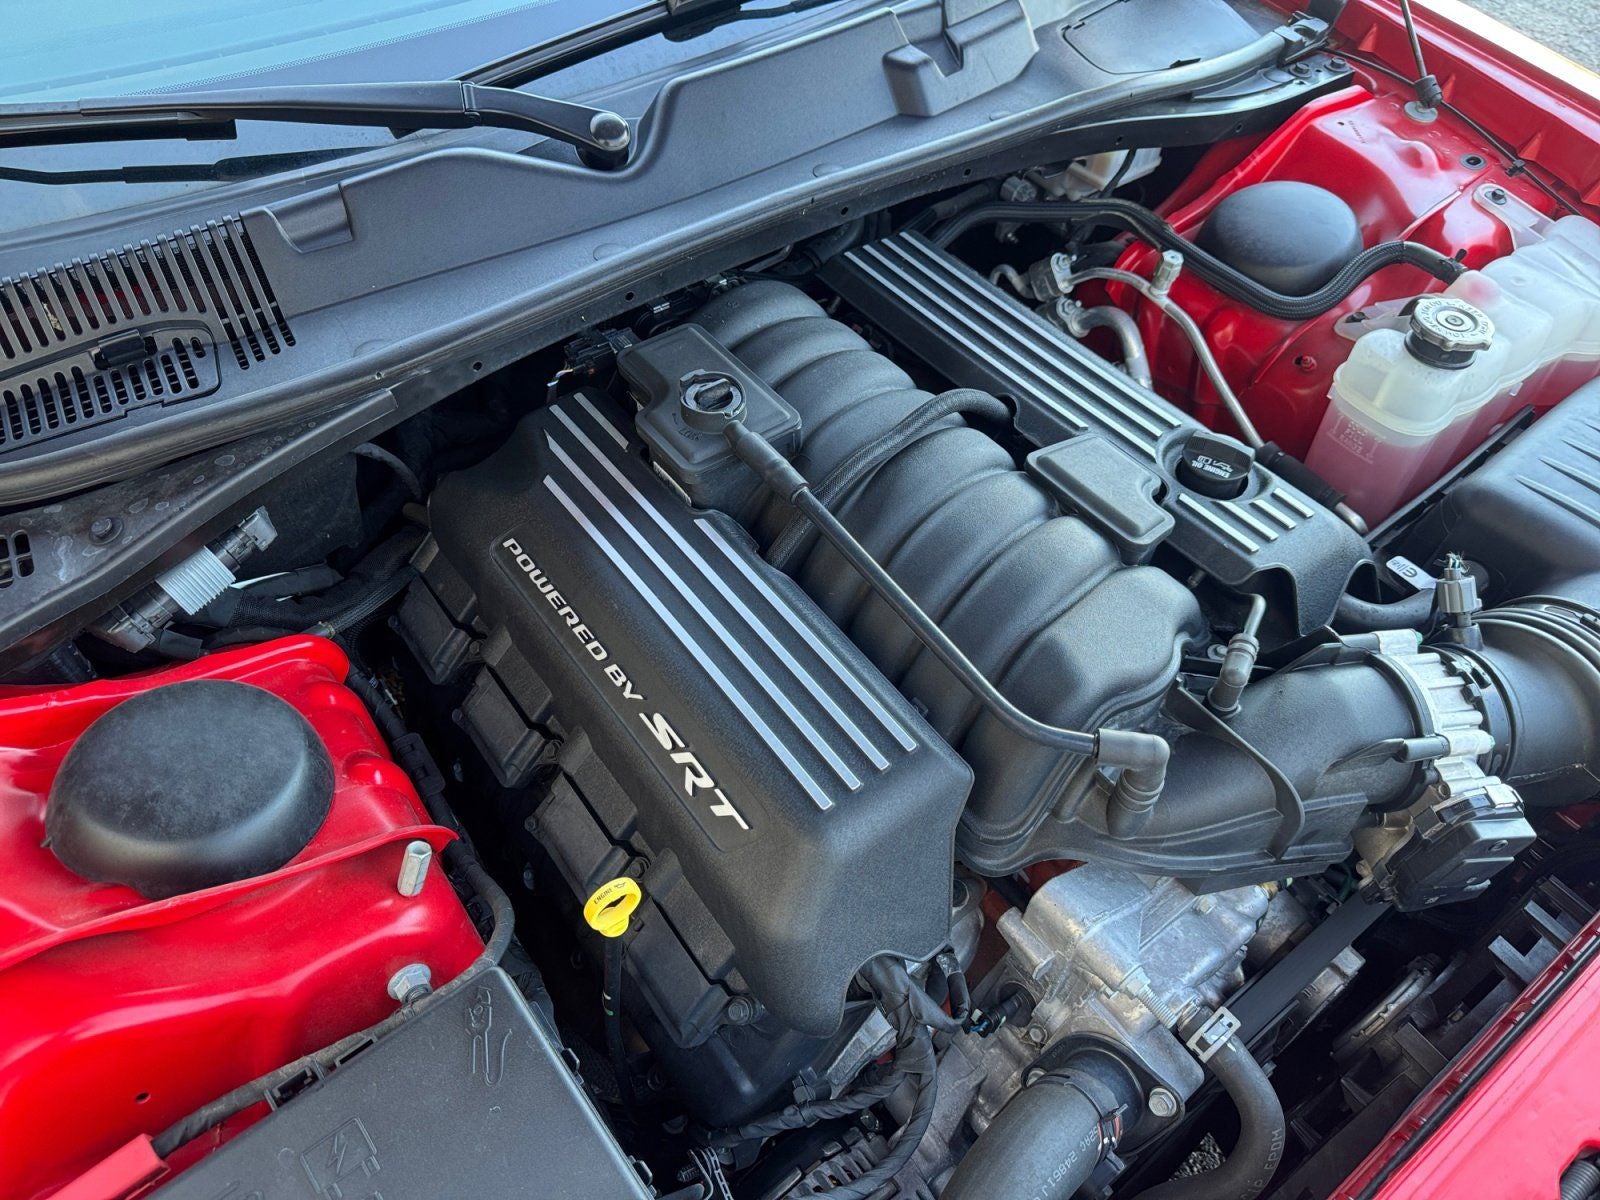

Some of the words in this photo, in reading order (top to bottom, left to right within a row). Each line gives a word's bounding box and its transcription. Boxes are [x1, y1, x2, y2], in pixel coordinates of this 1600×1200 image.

[1191, 460, 1204, 469] OIL
[1203, 464, 1231, 479] ENGINE
[502, 538, 608, 661] POWERED
[604, 664, 643, 700] BY
[639, 712, 750, 830] SRT
[593, 887, 613, 904] ENGINE
[1264, 1127, 1283, 1170] EPDM
